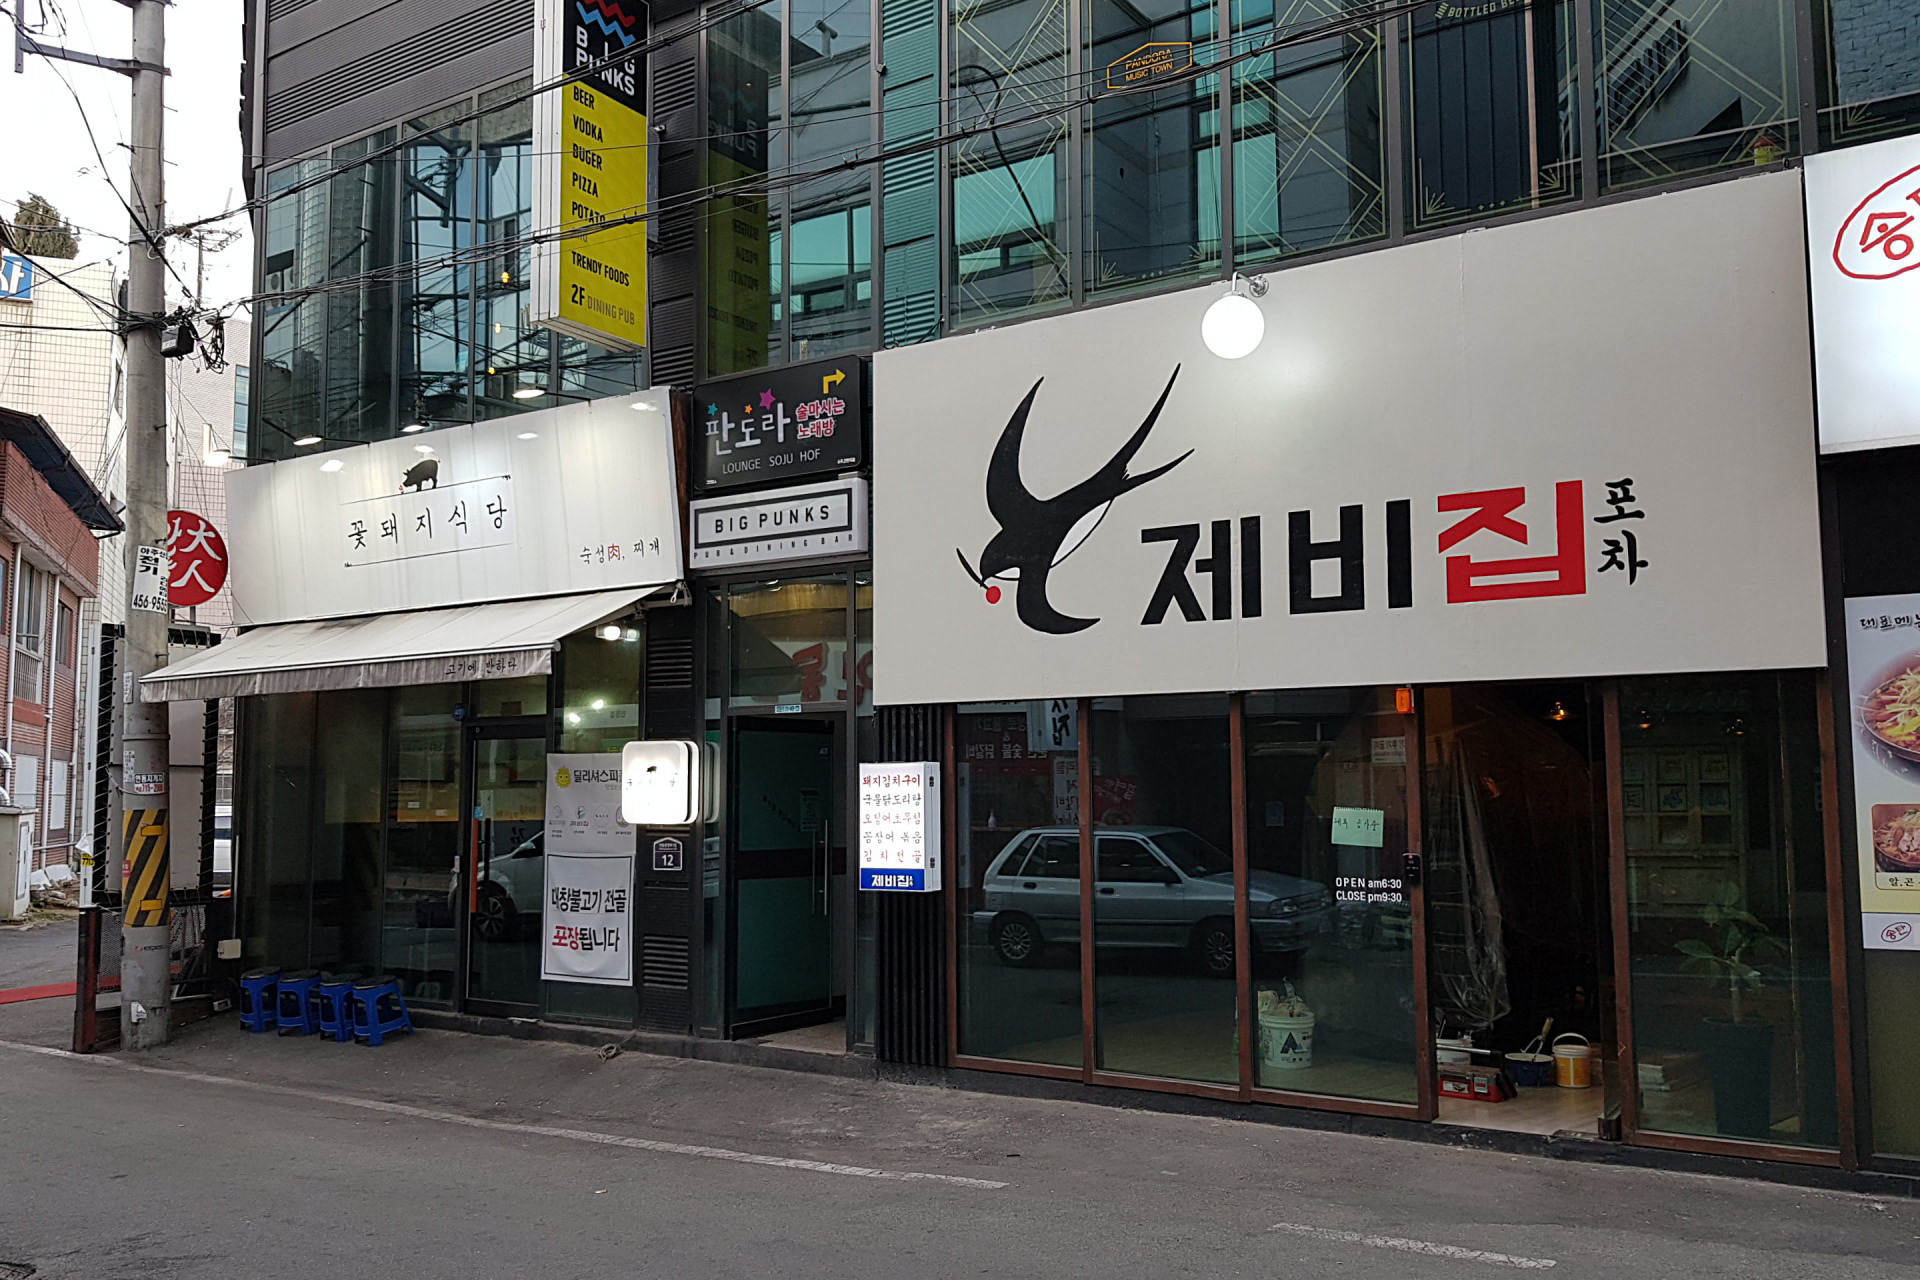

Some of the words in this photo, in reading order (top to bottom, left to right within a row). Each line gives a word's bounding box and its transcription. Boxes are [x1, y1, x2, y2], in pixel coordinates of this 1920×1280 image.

[1448, 2, 1496, 18] BOTTLED
[1125, 48, 1174, 70] PANDORA
[1125, 68, 1149, 82] MUSIC
[1151, 61, 1173, 77] TOWN
[573, 85, 595, 110] BEER
[572, 113, 603, 143] VODKA
[572, 143, 603, 172] BUGER
[572, 173, 599, 199] PIZZA
[571, 250, 602, 276] TRENDY
[604, 264, 630, 287] FOODS
[571, 284, 585, 306] 2F
[587, 295, 617, 319] DINING
[618, 308, 635, 325] PUB
[795, 397, 846, 421] 술마시는
[705, 402, 791, 456] 판도라
[796, 418, 835, 440] 노래방
[722, 458, 761, 475] LOUNGE
[769, 453, 794, 467] SOJU
[799, 449, 821, 462] HOF
[348, 494, 507, 550] 꽃돼지식당
[715, 516, 748, 533] BIG
[759, 505, 829, 528] PUNKS
[820, 534, 853, 545] BAR
[1593, 477, 1649, 586] 포차
[633, 537, 660, 558] 찌개
[1140, 479, 1587, 626] 제비집
[445, 661, 477, 677] 고기에
[485, 656, 518, 674] 반하다
[862, 773, 921, 788] 돼지김치구이
[862, 793, 922, 807] 국물닭도리탕
[863, 831, 894, 844] 꼼장어
[900, 831, 922, 844] 볶음
[661, 854, 674, 866] 12
[871, 874, 910, 887] 제비집
[1335, 877, 1366, 888] OPEN
[1367, 877, 1402, 889] am6:30
[551, 886, 602, 913] 대창불고기
[603, 888, 627, 914] 전골
[1335, 890, 1366, 901] CLOSE
[1367, 891, 1402, 903] pm9:30
[551, 925, 620, 952] 포장됩니다
